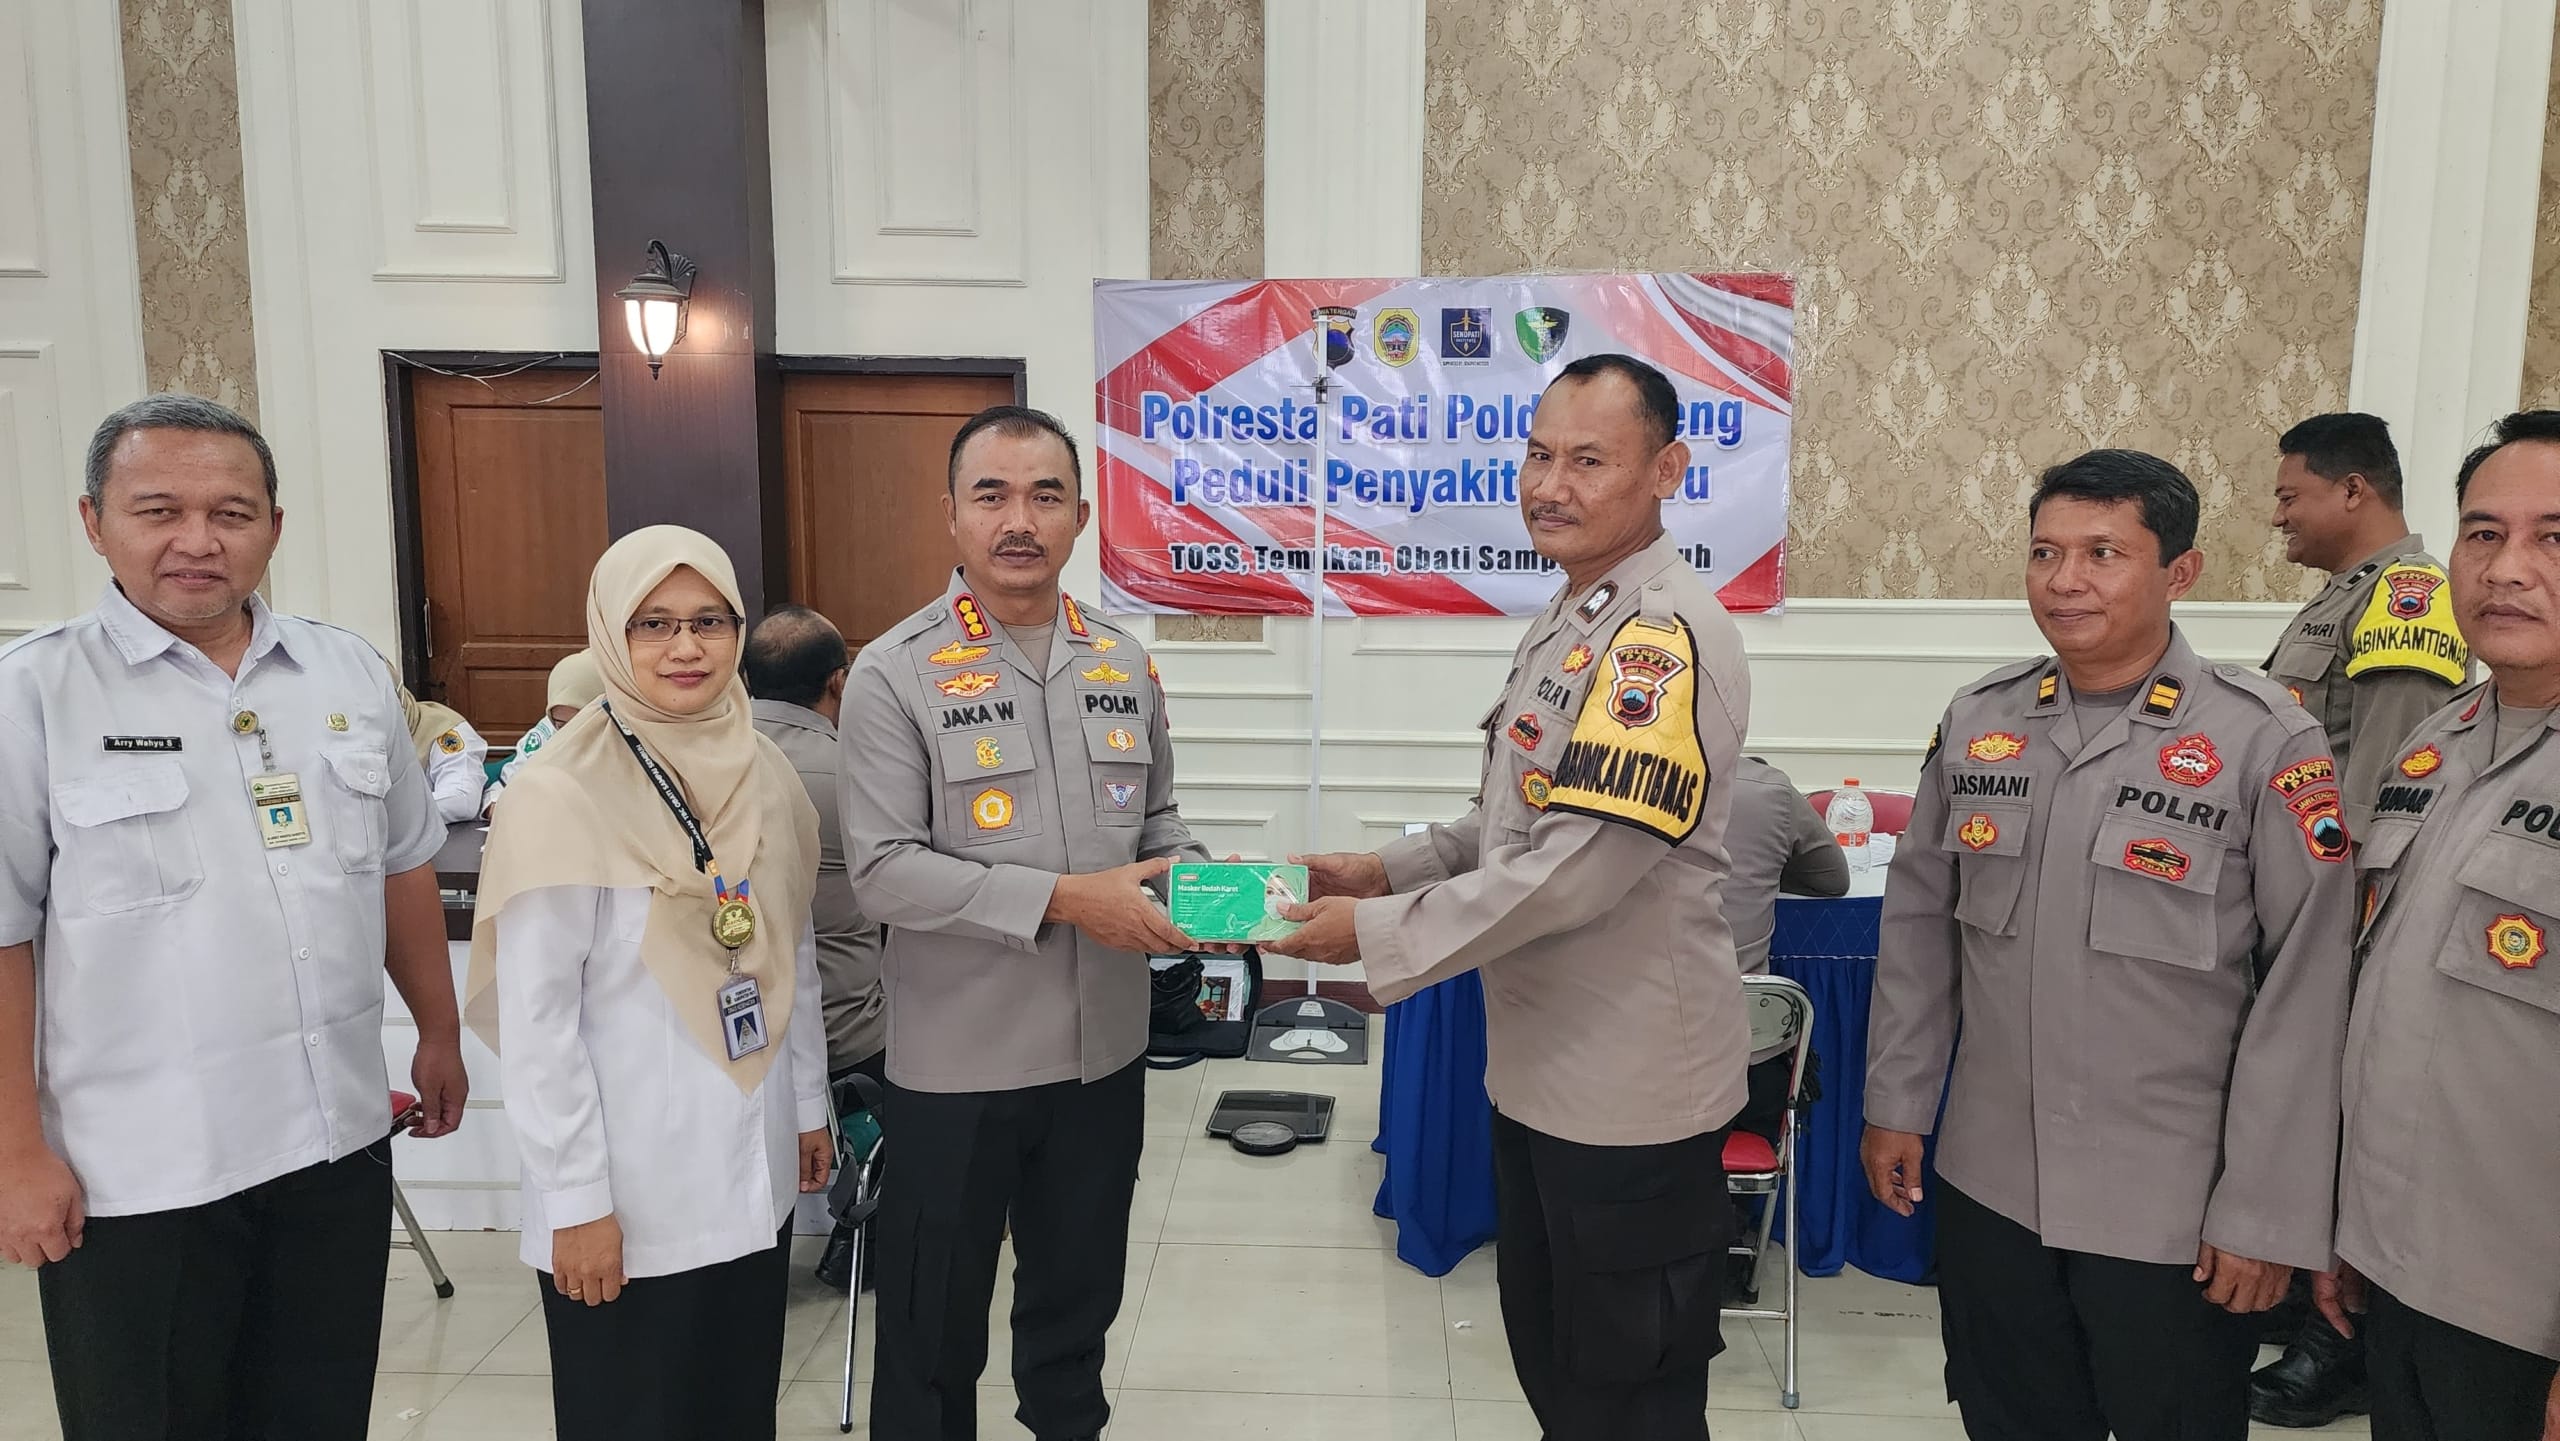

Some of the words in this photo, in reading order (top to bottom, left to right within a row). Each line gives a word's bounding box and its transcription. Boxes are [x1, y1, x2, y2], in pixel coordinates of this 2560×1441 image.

[1452, 330, 1480, 338] SENOPATI
[1143, 394, 1318, 440] Polresta
[1341, 394, 1428, 440] Pati
[1447, 393, 1541, 439] Pold
[1174, 458, 1308, 503] Peduli
[1326, 458, 1517, 514] Penyakit
[1171, 545, 1248, 574] TOSS,
[1396, 545, 1470, 571] Obati
[1478, 545, 1557, 573] Samp
[2301, 622, 2336, 638] POLRI
[1620, 648, 1673, 668] POLRESTA
[1626, 654, 1664, 668] PATI
[942, 704, 993, 729] JAKA
[994, 700, 1015, 721] W
[1084, 694, 1140, 715] POLRI
[114, 739, 133, 748] Arry
[135, 739, 164, 748] Wahyu
[2275, 760, 2331, 789] POLRESTA
[2290, 769, 2328, 789] PATI
[1951, 774, 2030, 798] JASMANI
[2115, 785, 2229, 832] POLRI
[1178, 884, 1200, 892] Masker
[1201, 884, 1220, 892] Bedah
[1221, 885, 1239, 893] Karet
